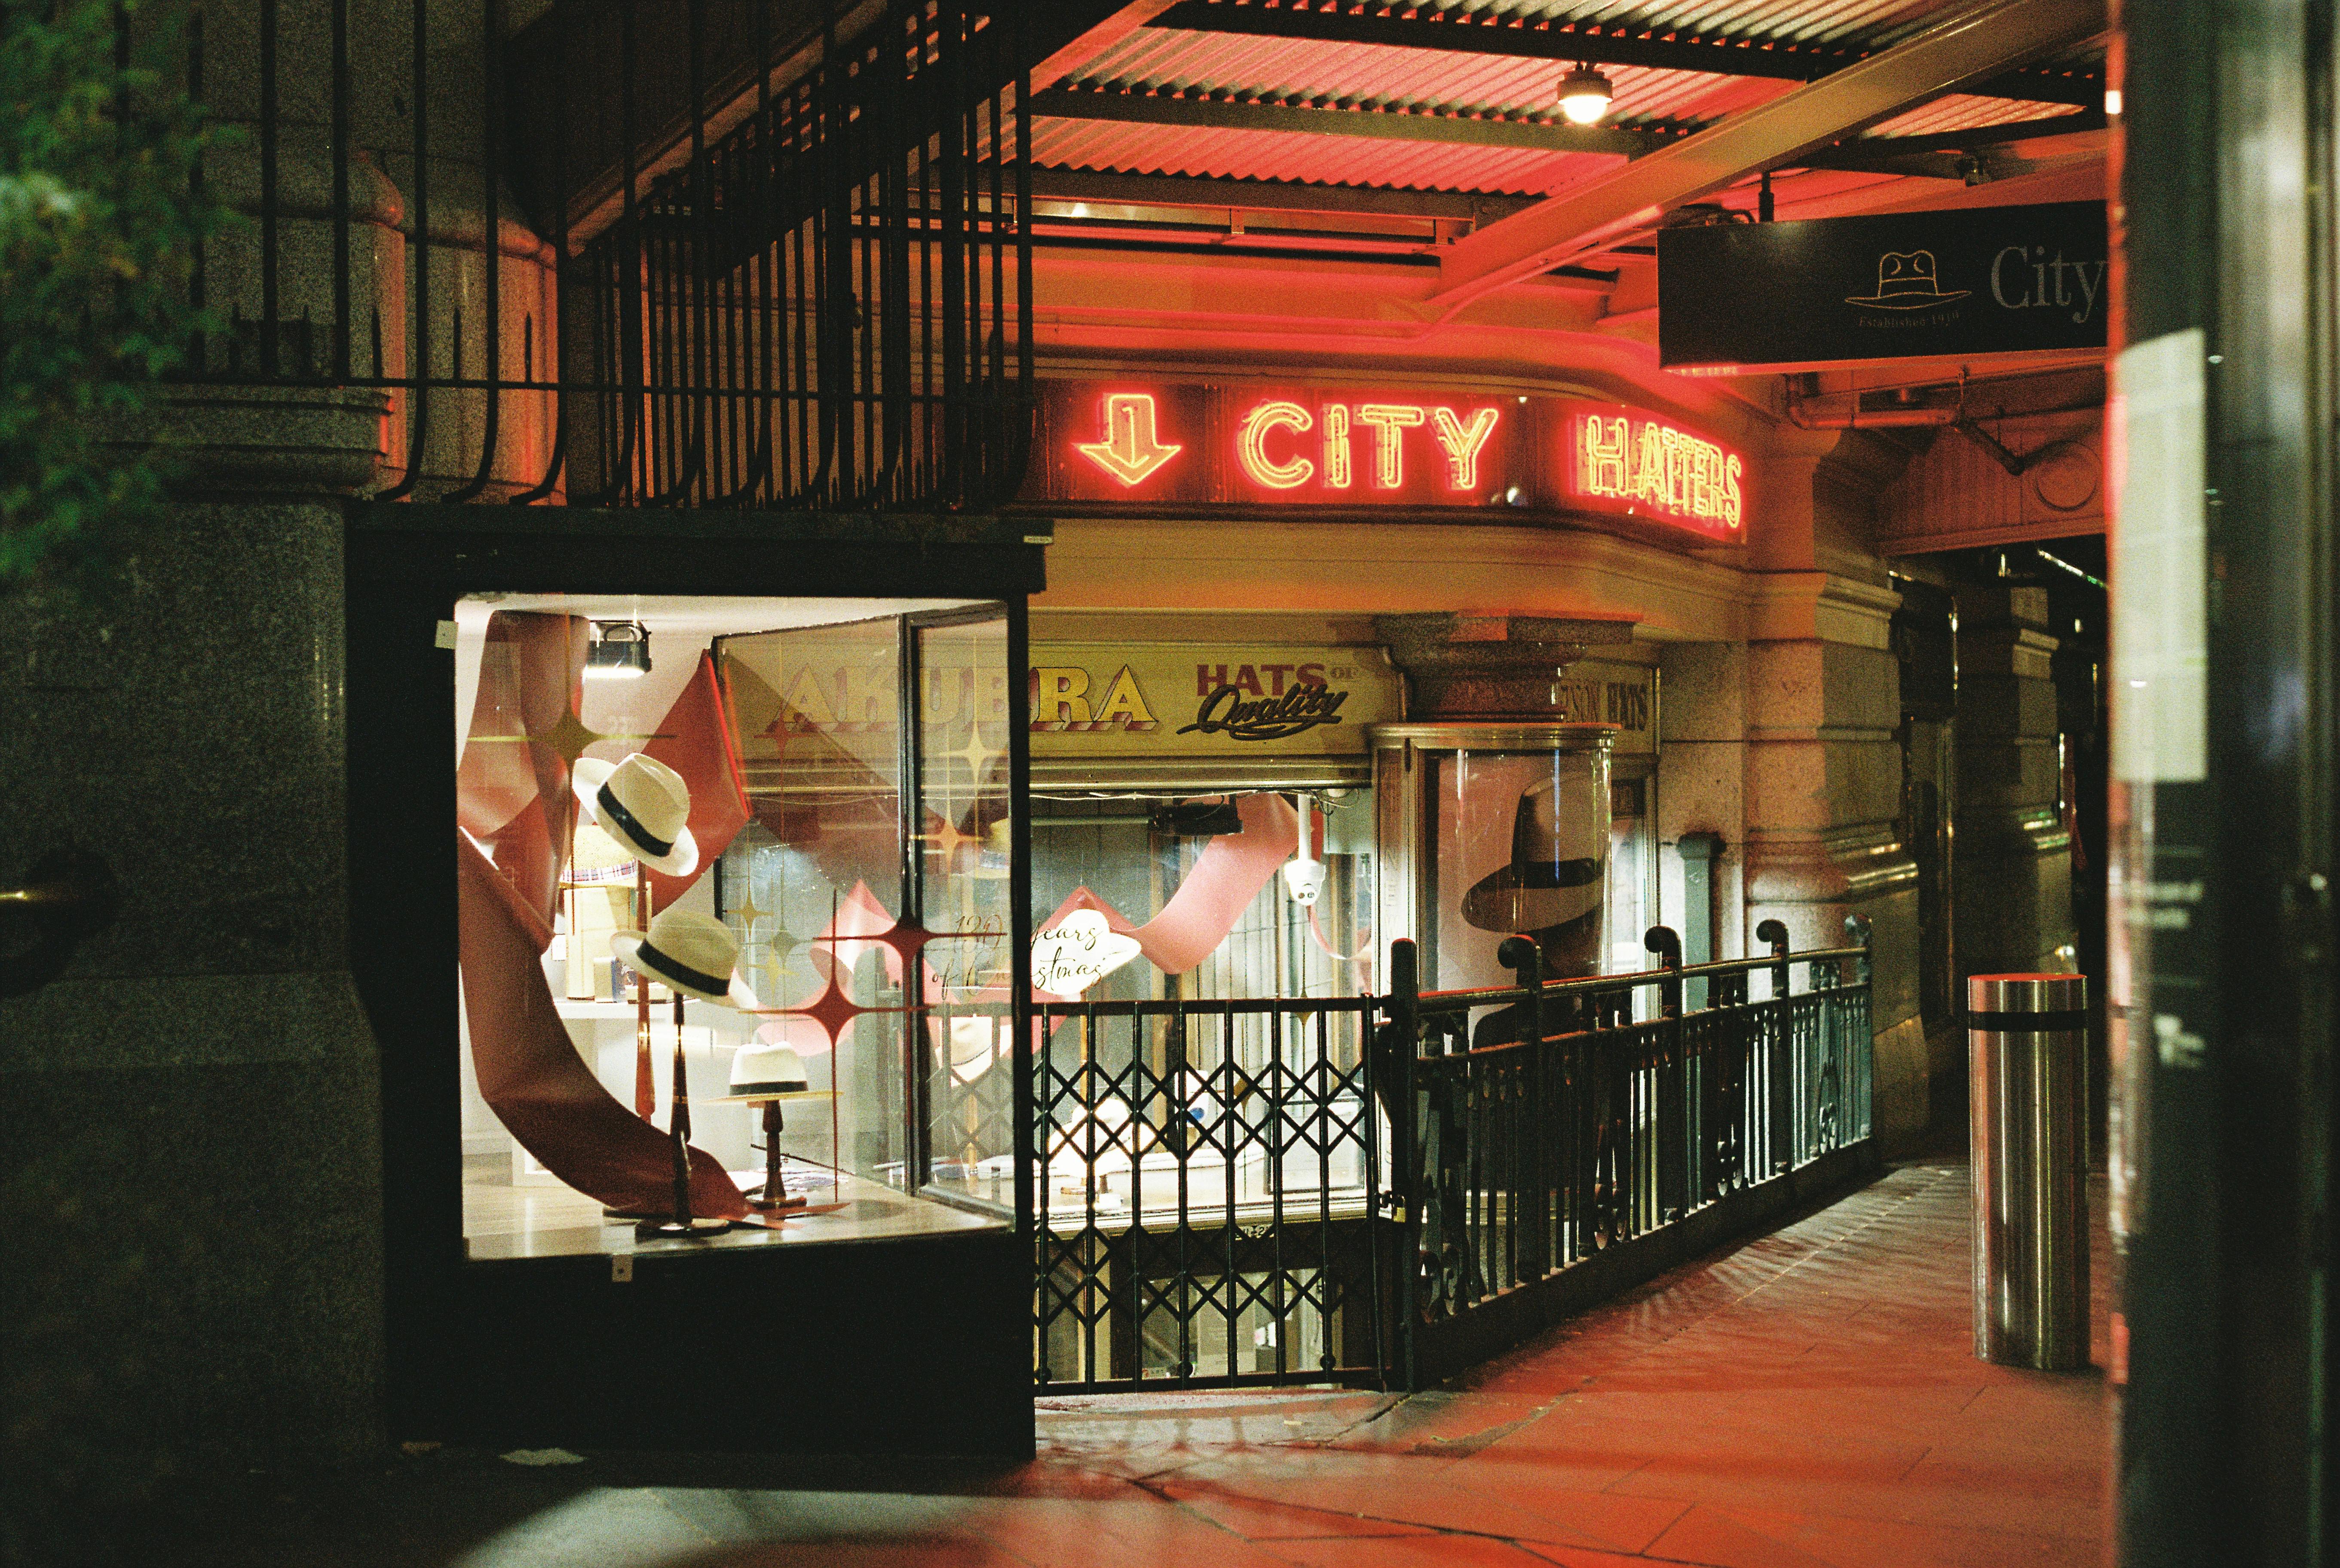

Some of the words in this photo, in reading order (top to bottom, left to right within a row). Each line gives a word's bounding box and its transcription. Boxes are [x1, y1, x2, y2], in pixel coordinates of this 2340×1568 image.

[1991, 246, 2107, 323] City
[1234, 401, 1499, 490] CITY
[1577, 414, 1742, 529] HATTERS
[763, 663, 1158, 732] AKUBRA
[1176, 682, 1349, 741] Quality
[1197, 663, 1328, 696] HATS
